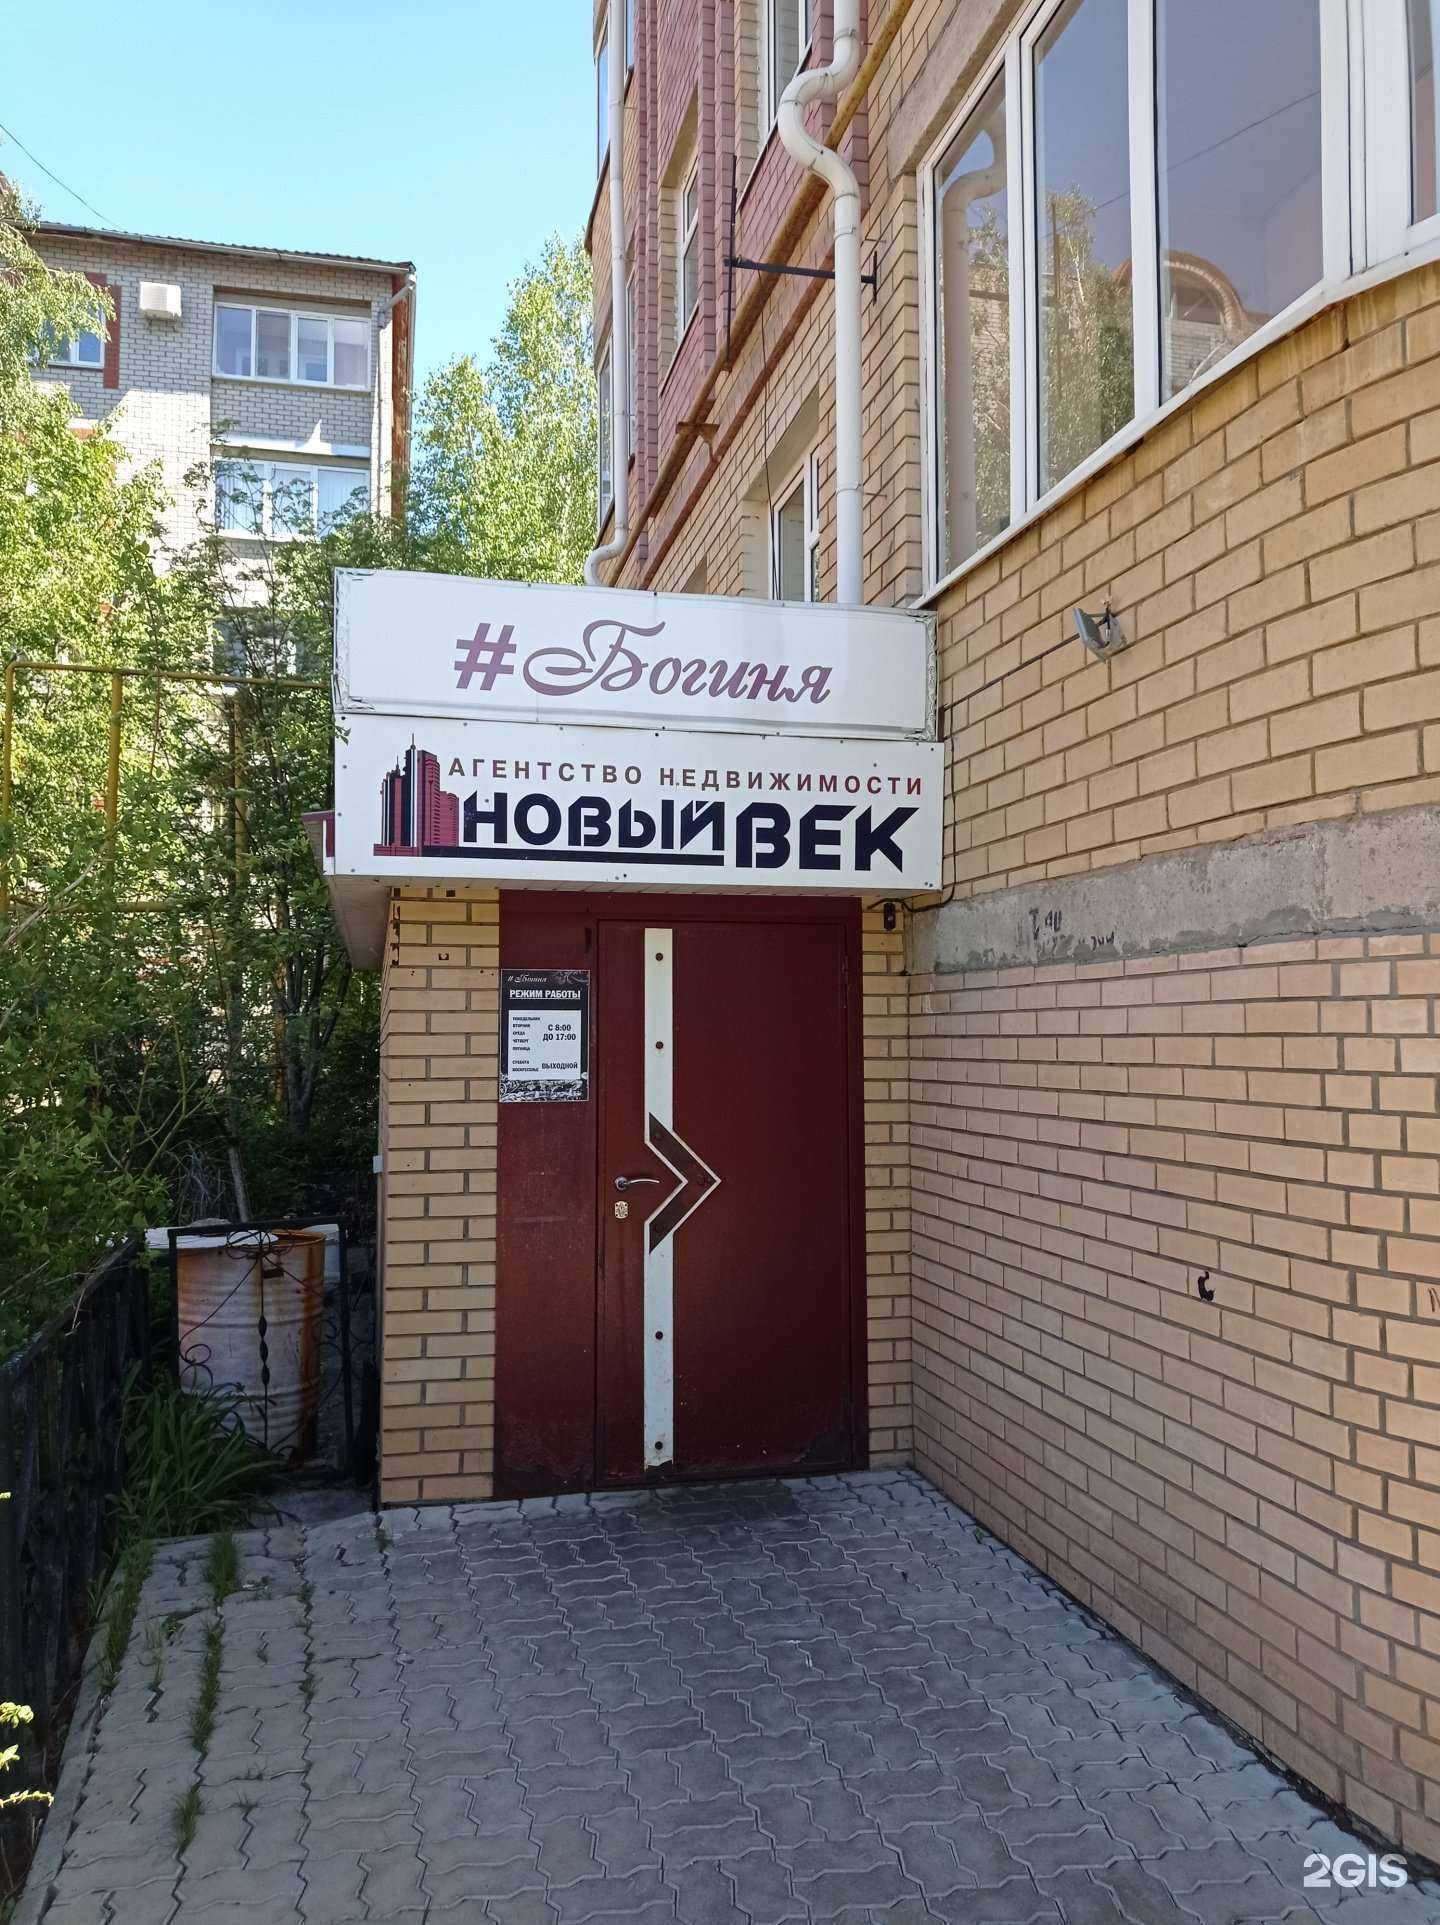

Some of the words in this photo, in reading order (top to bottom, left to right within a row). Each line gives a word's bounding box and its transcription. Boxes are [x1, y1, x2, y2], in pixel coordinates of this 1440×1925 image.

[454, 619, 833, 704] #Богиня
[448, 758, 642, 784] АГЕНТСТВО
[659, 767, 922, 796] НЕДВИЖИМОСТИ
[509, 989, 543, 998] РЕЖИМ
[545, 989, 581, 998] РАБОТЫ
[542, 1033, 554, 1042] ДО
[556, 1033, 577, 1041] 17:00
[541, 1061, 578, 1070] ВЫХОДНОЙ
